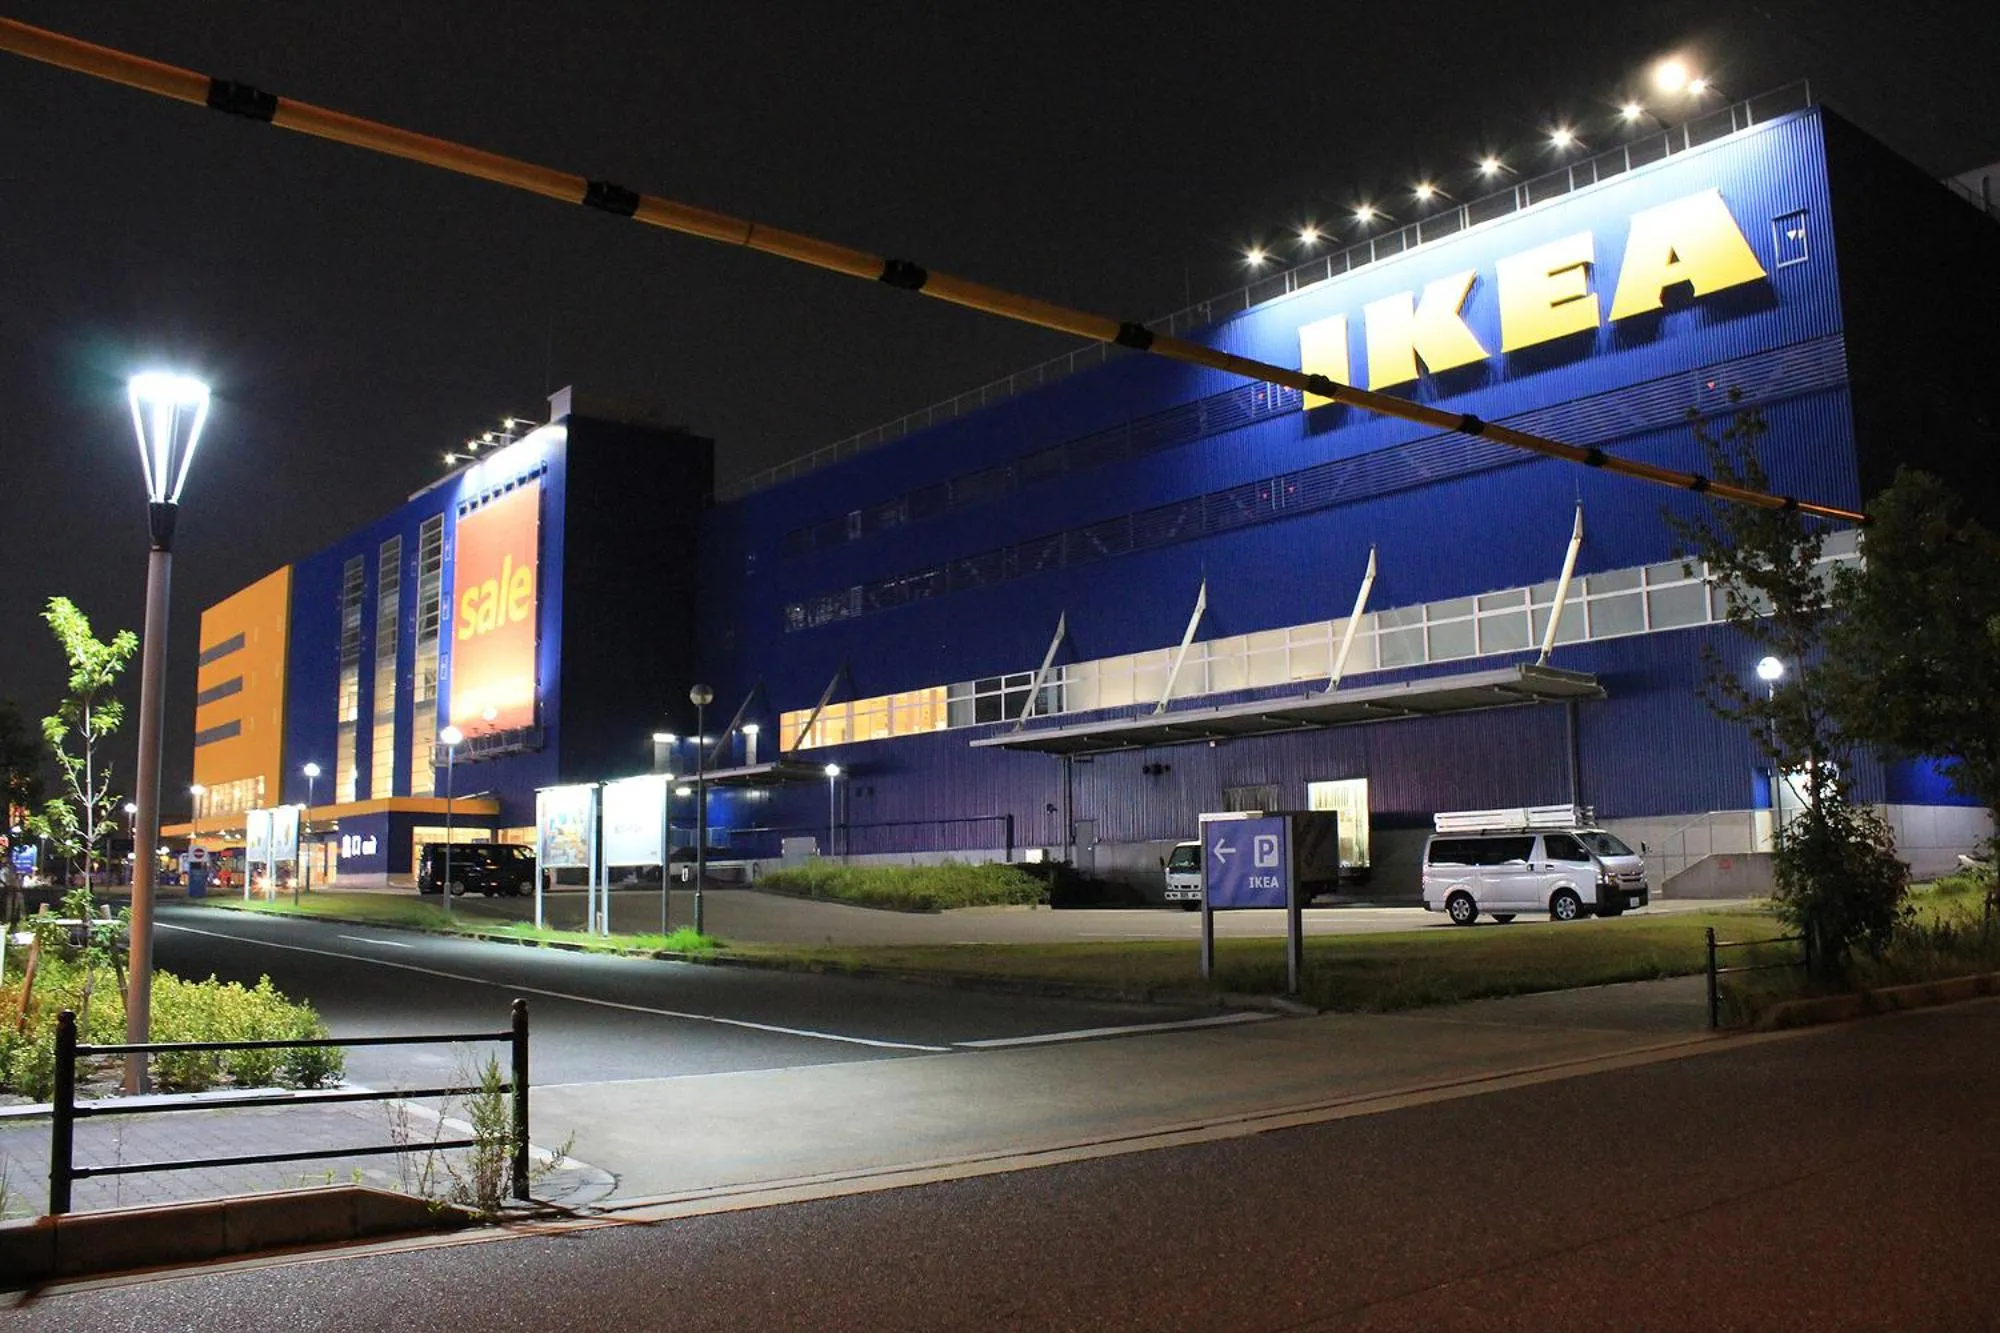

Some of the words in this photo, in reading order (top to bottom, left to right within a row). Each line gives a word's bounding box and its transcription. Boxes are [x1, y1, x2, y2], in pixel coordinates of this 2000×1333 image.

[1299, 188, 1768, 411] IKEA
[458, 554, 533, 642] sale
[1258, 839, 1274, 864] P
[1248, 876, 1279, 889] IKEA
